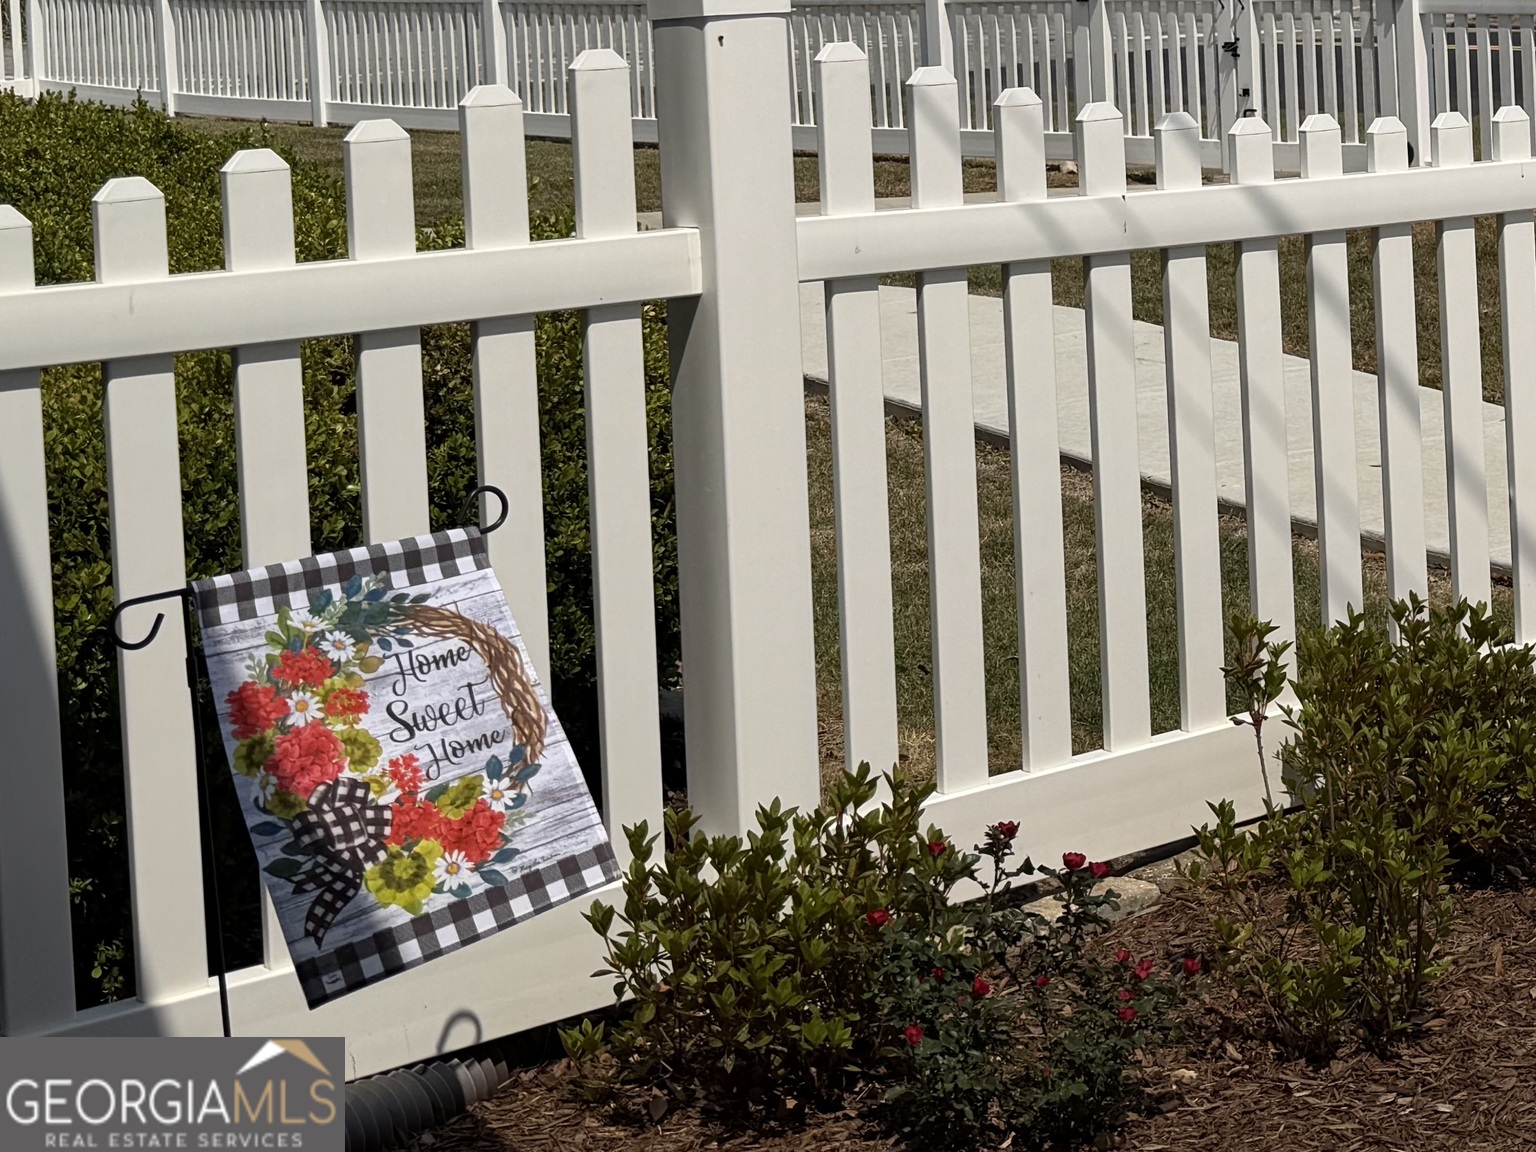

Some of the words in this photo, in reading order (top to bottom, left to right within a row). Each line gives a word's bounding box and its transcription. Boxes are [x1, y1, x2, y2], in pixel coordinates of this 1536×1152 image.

[383, 645, 473, 697] Home
[386, 676, 488, 743] Sweet
[414, 729, 505, 781] Home
